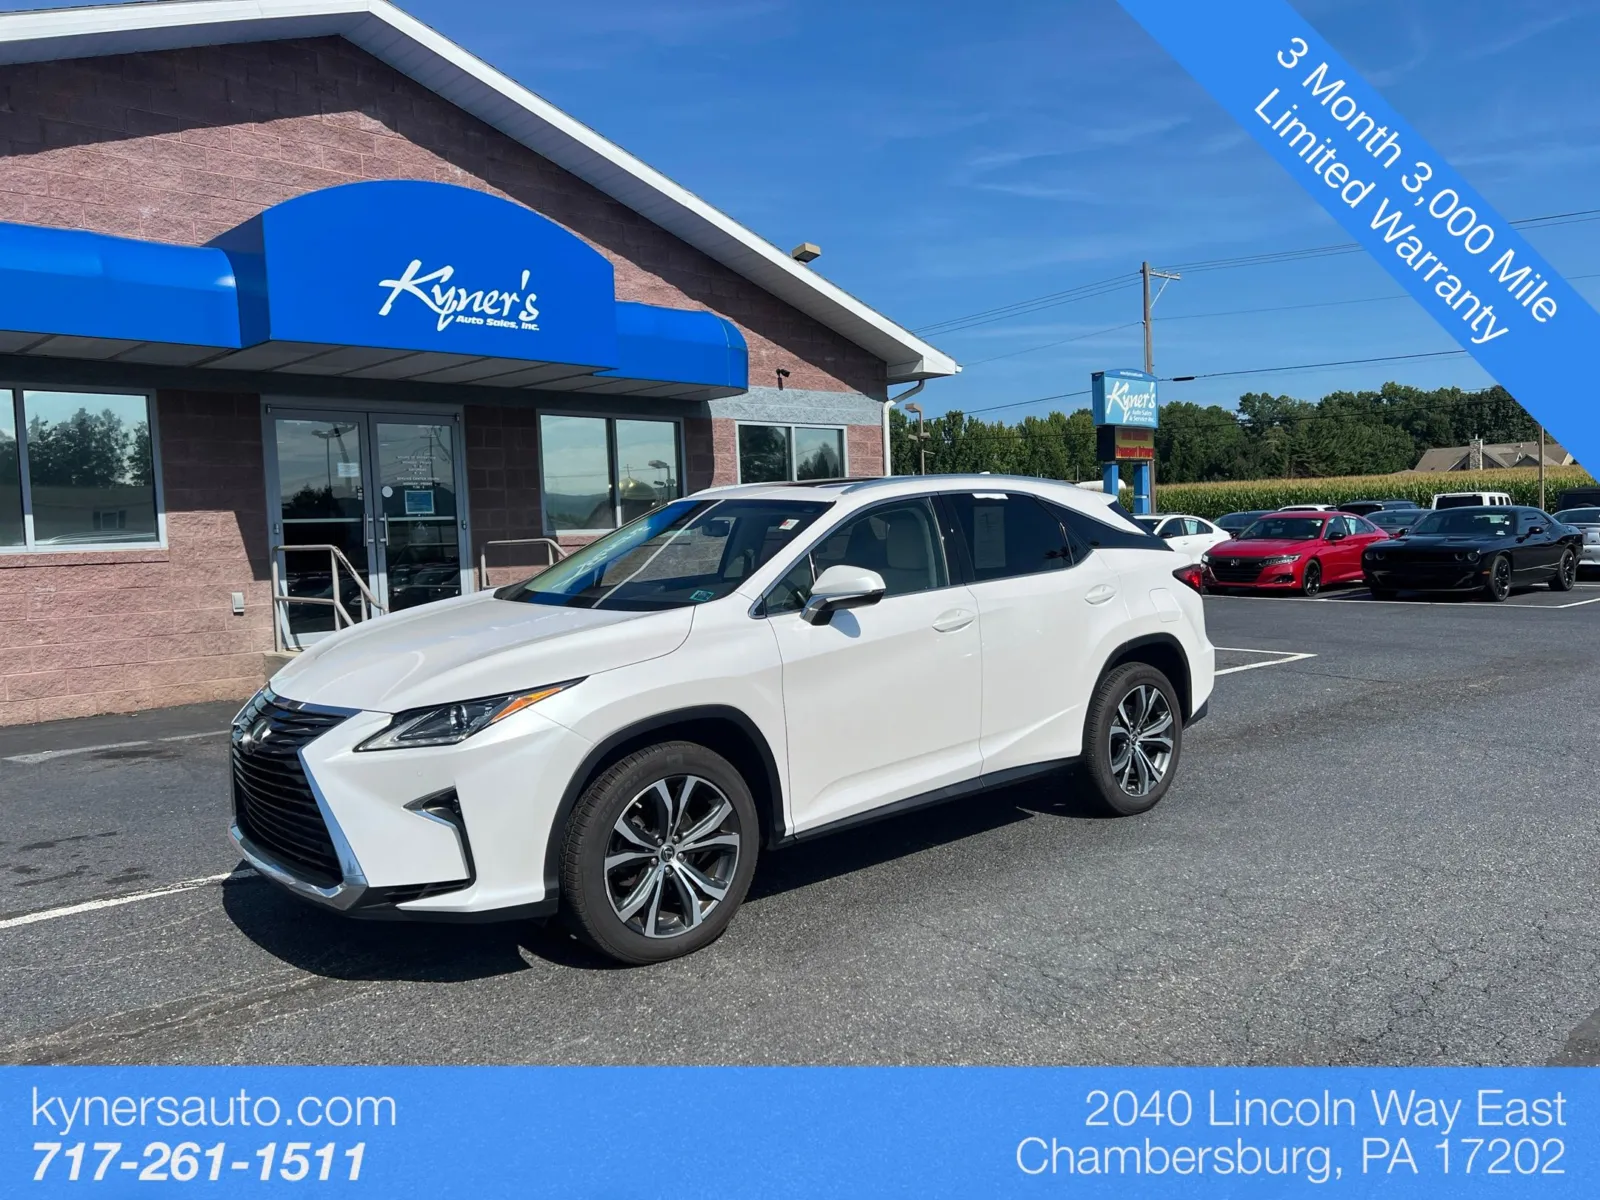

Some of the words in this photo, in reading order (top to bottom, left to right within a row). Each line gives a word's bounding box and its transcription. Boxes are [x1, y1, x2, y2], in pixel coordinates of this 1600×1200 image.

[379, 259, 540, 332] Kyner's
[455, 315, 484, 325] Auto
[486, 317, 519, 330] Sales,
[521, 321, 540, 332] Inc.
[1106, 380, 1156, 423] Kyner's
